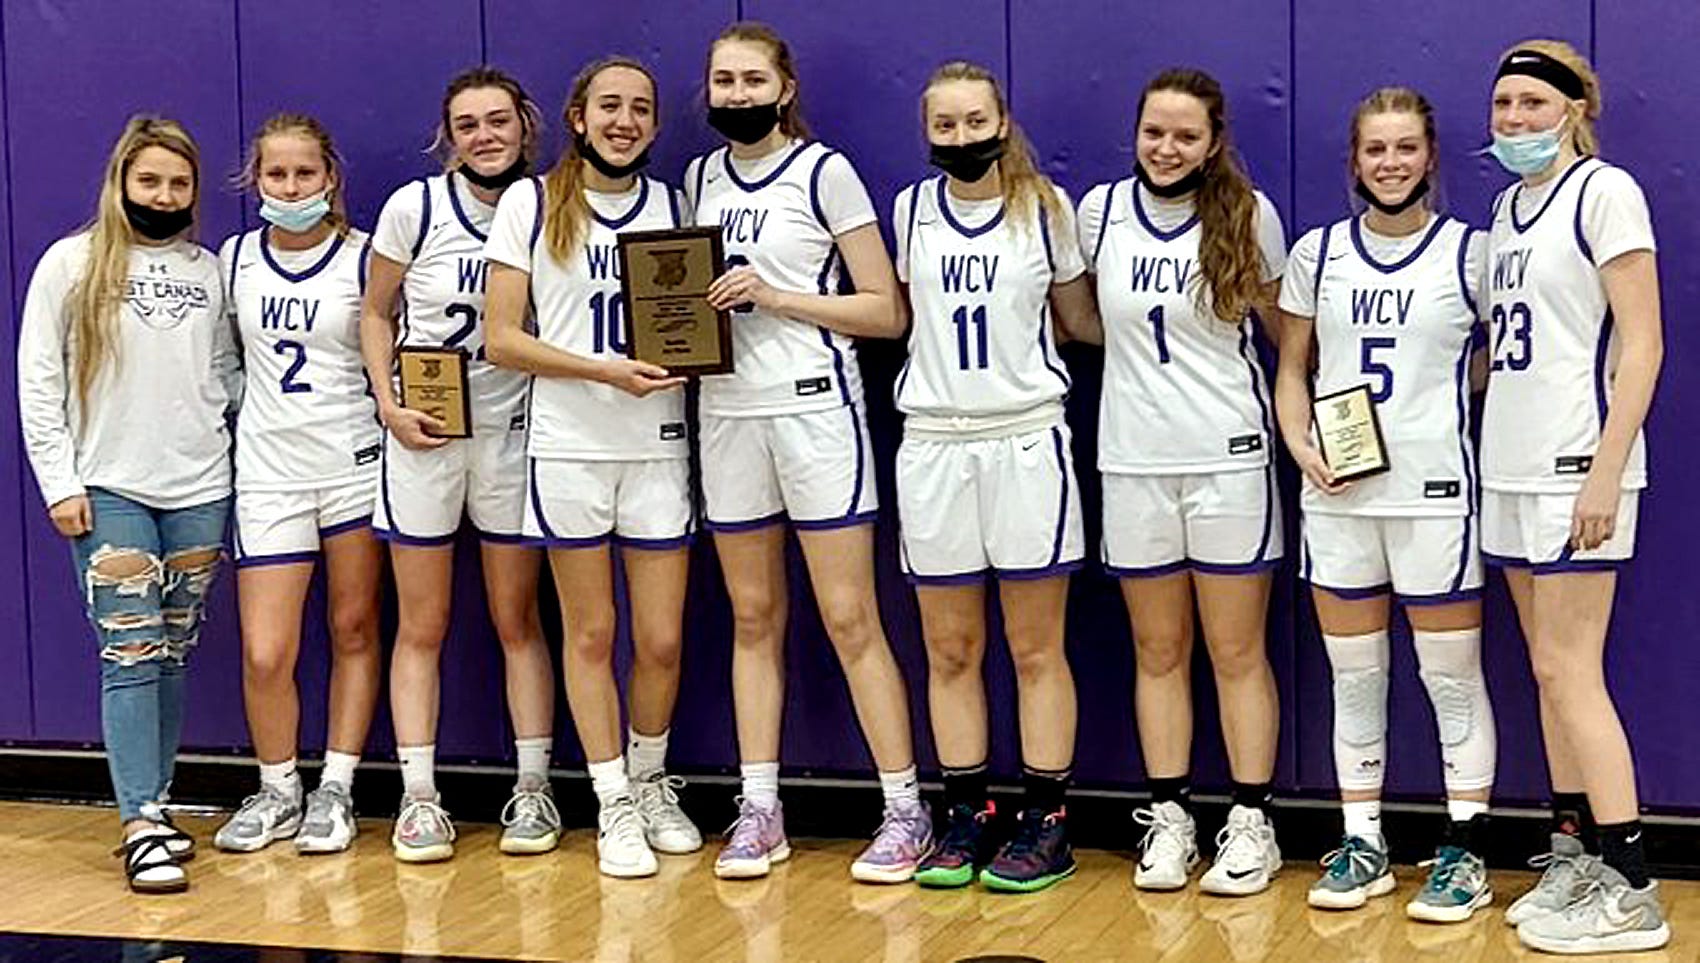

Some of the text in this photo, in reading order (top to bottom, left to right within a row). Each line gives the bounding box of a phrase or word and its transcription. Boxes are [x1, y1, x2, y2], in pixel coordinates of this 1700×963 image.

[719, 207, 769, 244] WCV
[585, 244, 622, 280] WC
[941, 254, 999, 293] WCV
[1131, 255, 1191, 294] WCV
[1492, 247, 1532, 290] WCV
[260, 295, 320, 332] WCV
[1351, 288, 1415, 325] WCV
[952, 304, 988, 370] 11
[1148, 305, 1171, 364] 1
[1490, 302, 1532, 371] 23
[273, 338, 313, 394] 2
[1360, 337, 1396, 404] 5
